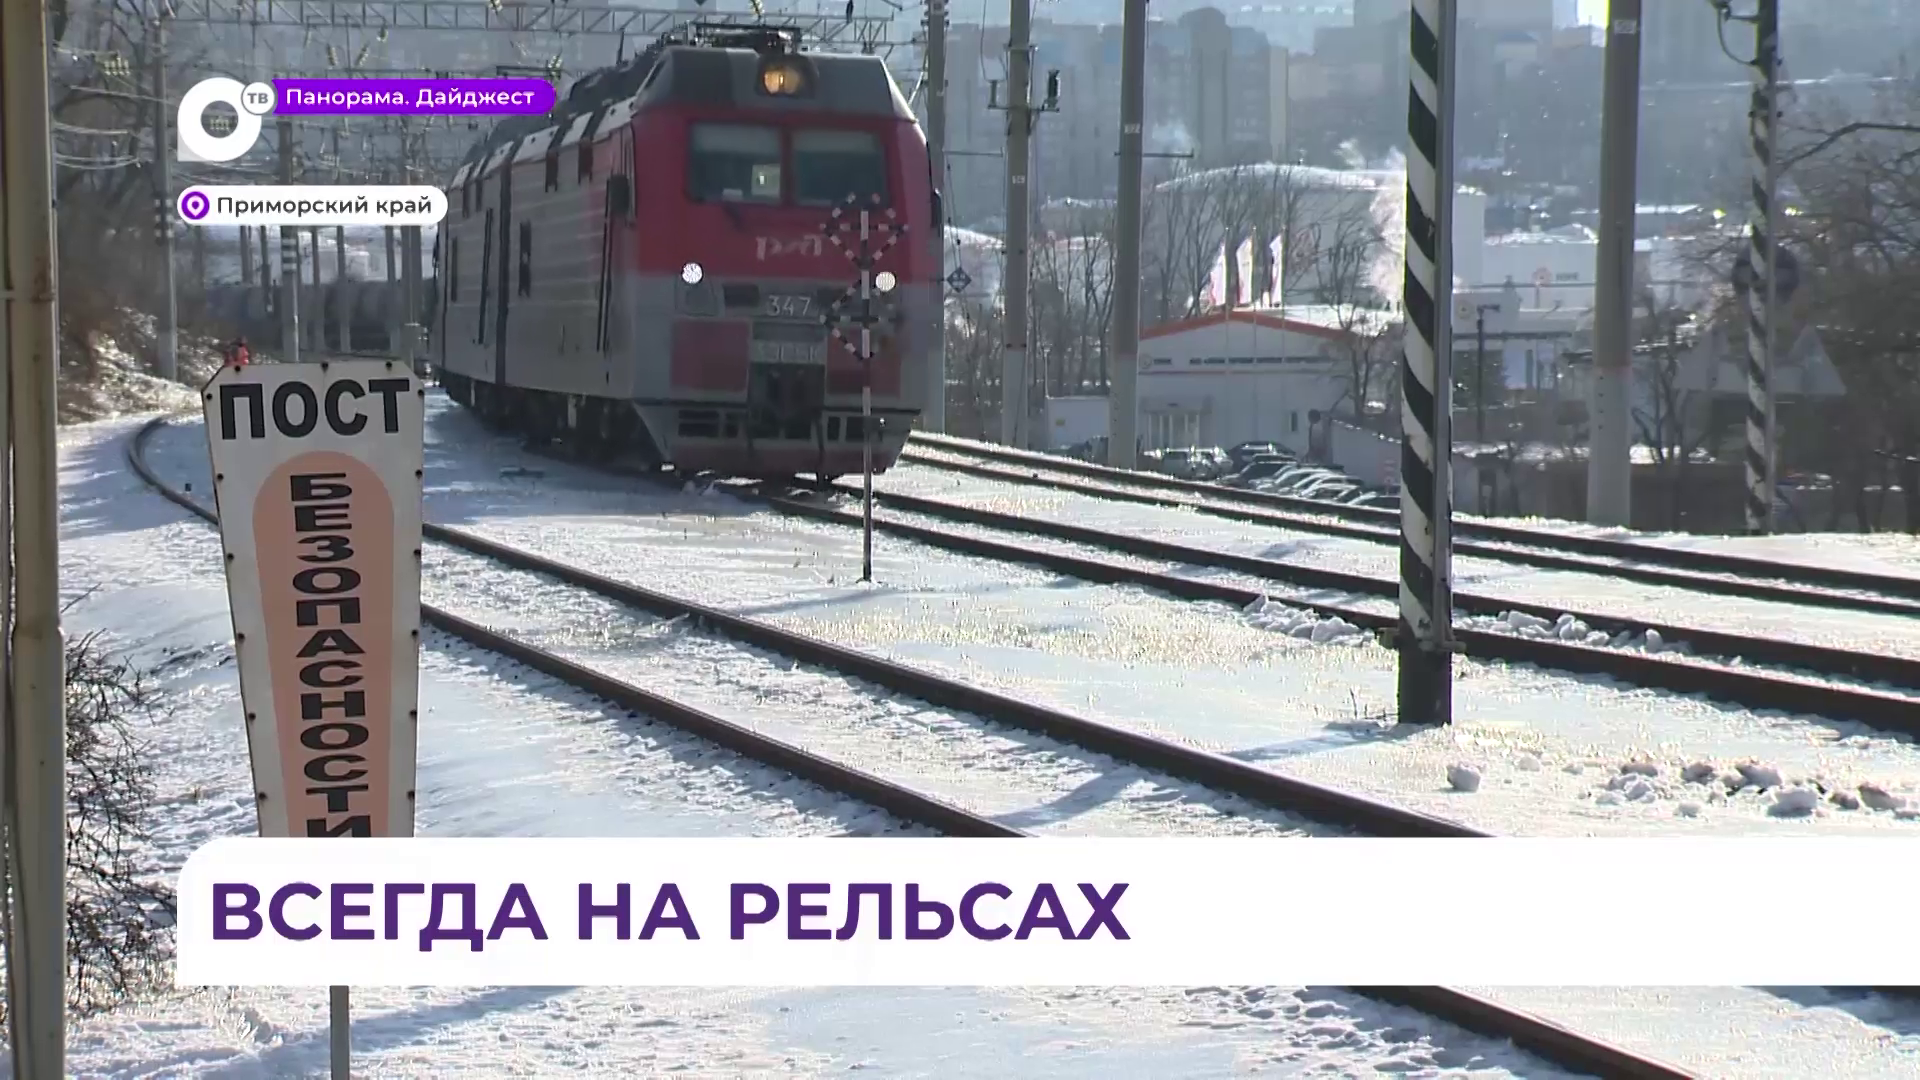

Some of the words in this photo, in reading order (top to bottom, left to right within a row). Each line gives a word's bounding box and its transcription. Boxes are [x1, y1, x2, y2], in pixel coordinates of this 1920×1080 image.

[767, 295, 811, 316] 347
[219, 377, 410, 440] ПОСТ
[289, 472, 372, 837] БЕЗОПАСНОСТИ
